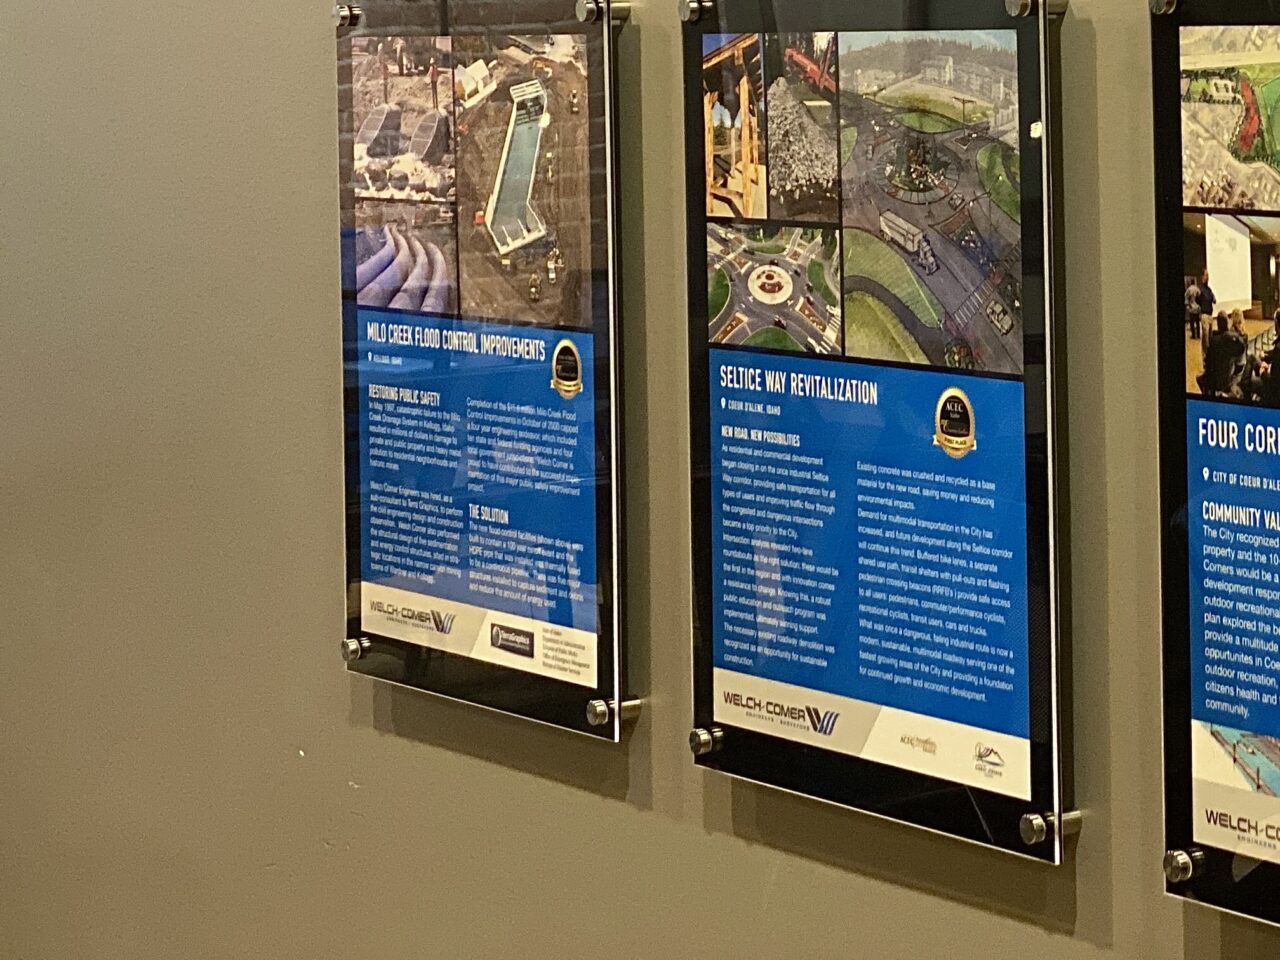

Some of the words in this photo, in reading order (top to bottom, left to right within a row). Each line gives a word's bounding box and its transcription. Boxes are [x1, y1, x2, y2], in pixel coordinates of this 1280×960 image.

[367, 322, 386, 343] MILO
[388, 324, 413, 345] CREEK
[415, 326, 440, 348] FLOOD
[442, 330, 478, 353] CONTROL
[480, 334, 545, 361] IMPROVEMENTS
[369, 384, 398, 401] RESTORING
[399, 388, 419, 404] PUBLIC
[420, 391, 439, 406] SAFETY
[720, 366, 761, 391] SELTICE
[765, 370, 786, 394] WAY
[790, 373, 877, 404] REVITALIZATION
[721, 426, 732, 437] NEW
[750, 430, 762, 441] NEW
[763, 431, 800, 446] POSSIBILITIES
[1198, 418, 1238, 449] FOUR
[1212, 471, 1227, 483] CITY
[1229, 473, 1237, 484] OF
[1239, 474, 1260, 488] COEUR
[469, 504, 479, 519] THE
[480, 506, 508, 524] SOLUTION
[1202, 501, 1260, 528] COMMUNITY
[1203, 525, 1217, 538] The
[1219, 528, 1234, 543] City
[1236, 533, 1279, 548] recognized
